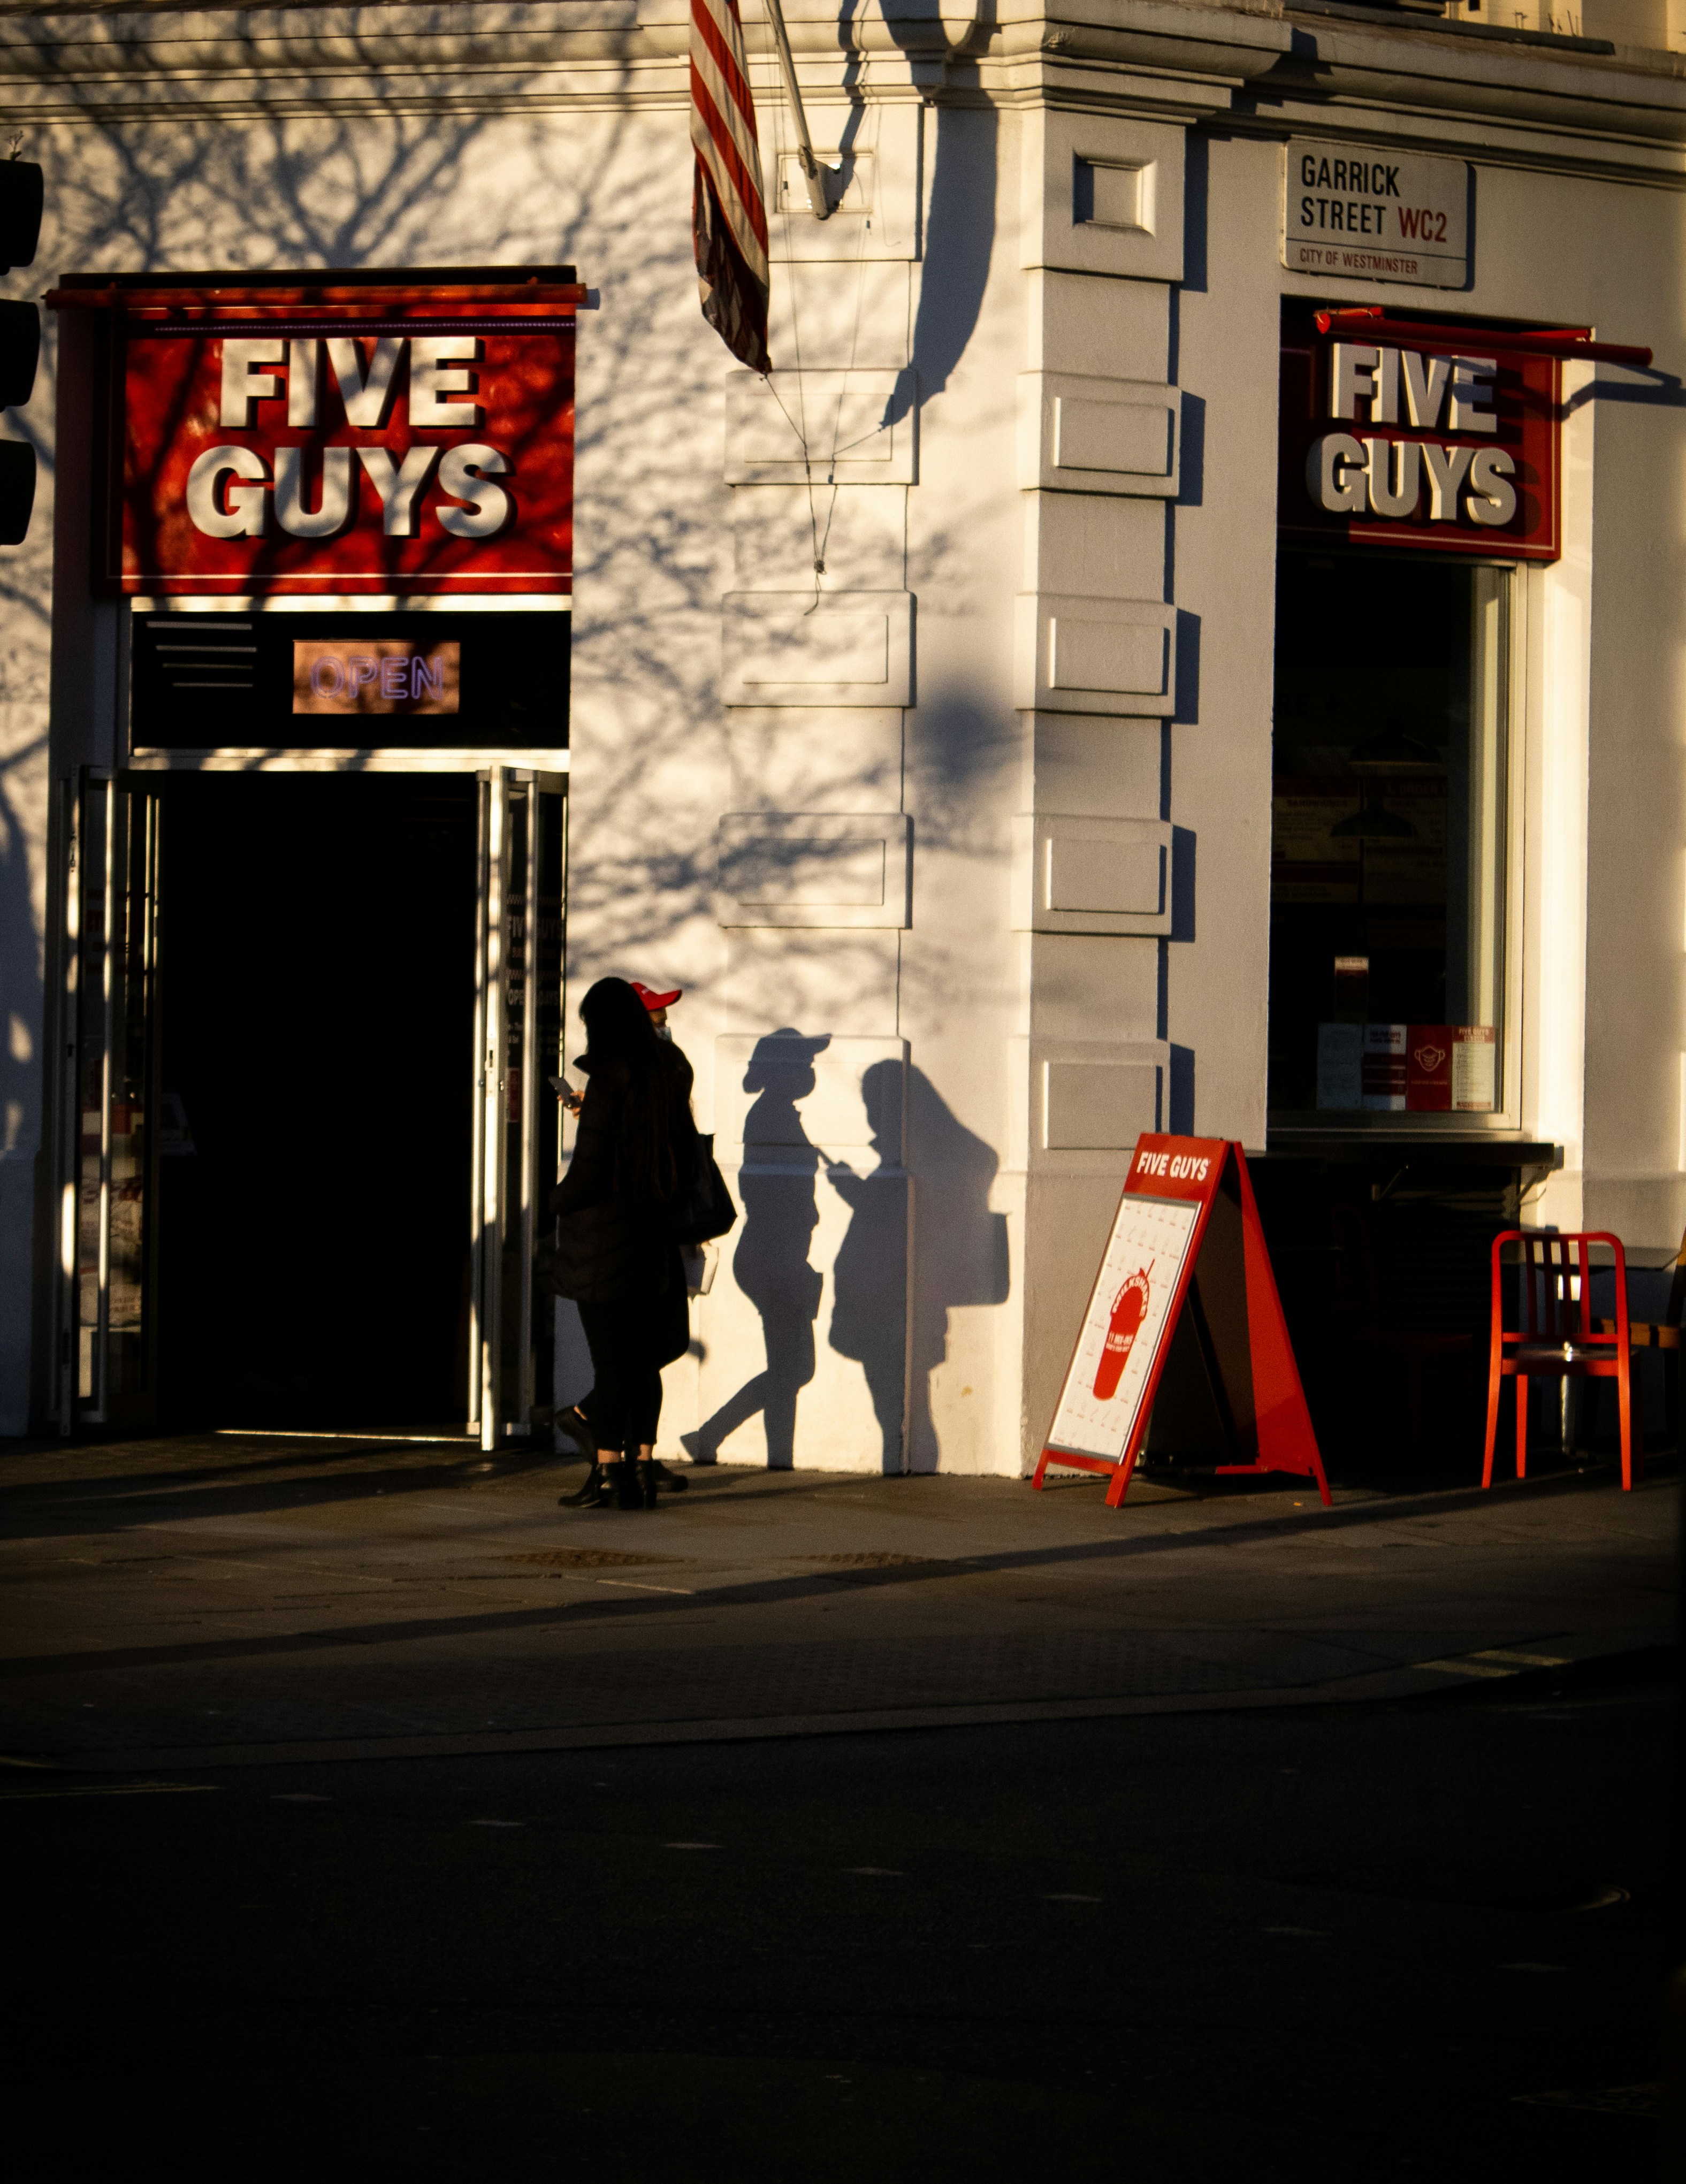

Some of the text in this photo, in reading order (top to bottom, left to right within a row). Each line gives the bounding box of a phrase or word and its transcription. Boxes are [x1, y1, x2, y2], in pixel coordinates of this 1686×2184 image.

[1301, 155, 1400, 197] GARRICK
[1300, 196, 1447, 243] STREET WC2
[1300, 248, 1418, 274] CITY OF WESTMINSTER
[219, 336, 483, 428] FIVE
[1332, 342, 1498, 433] FIVE
[186, 443, 516, 538] GUYS
[1311, 433, 1516, 525] GUYS
[310, 656, 443, 700] OPEN
[1136, 1151, 1209, 1181] FIVE GUYS
